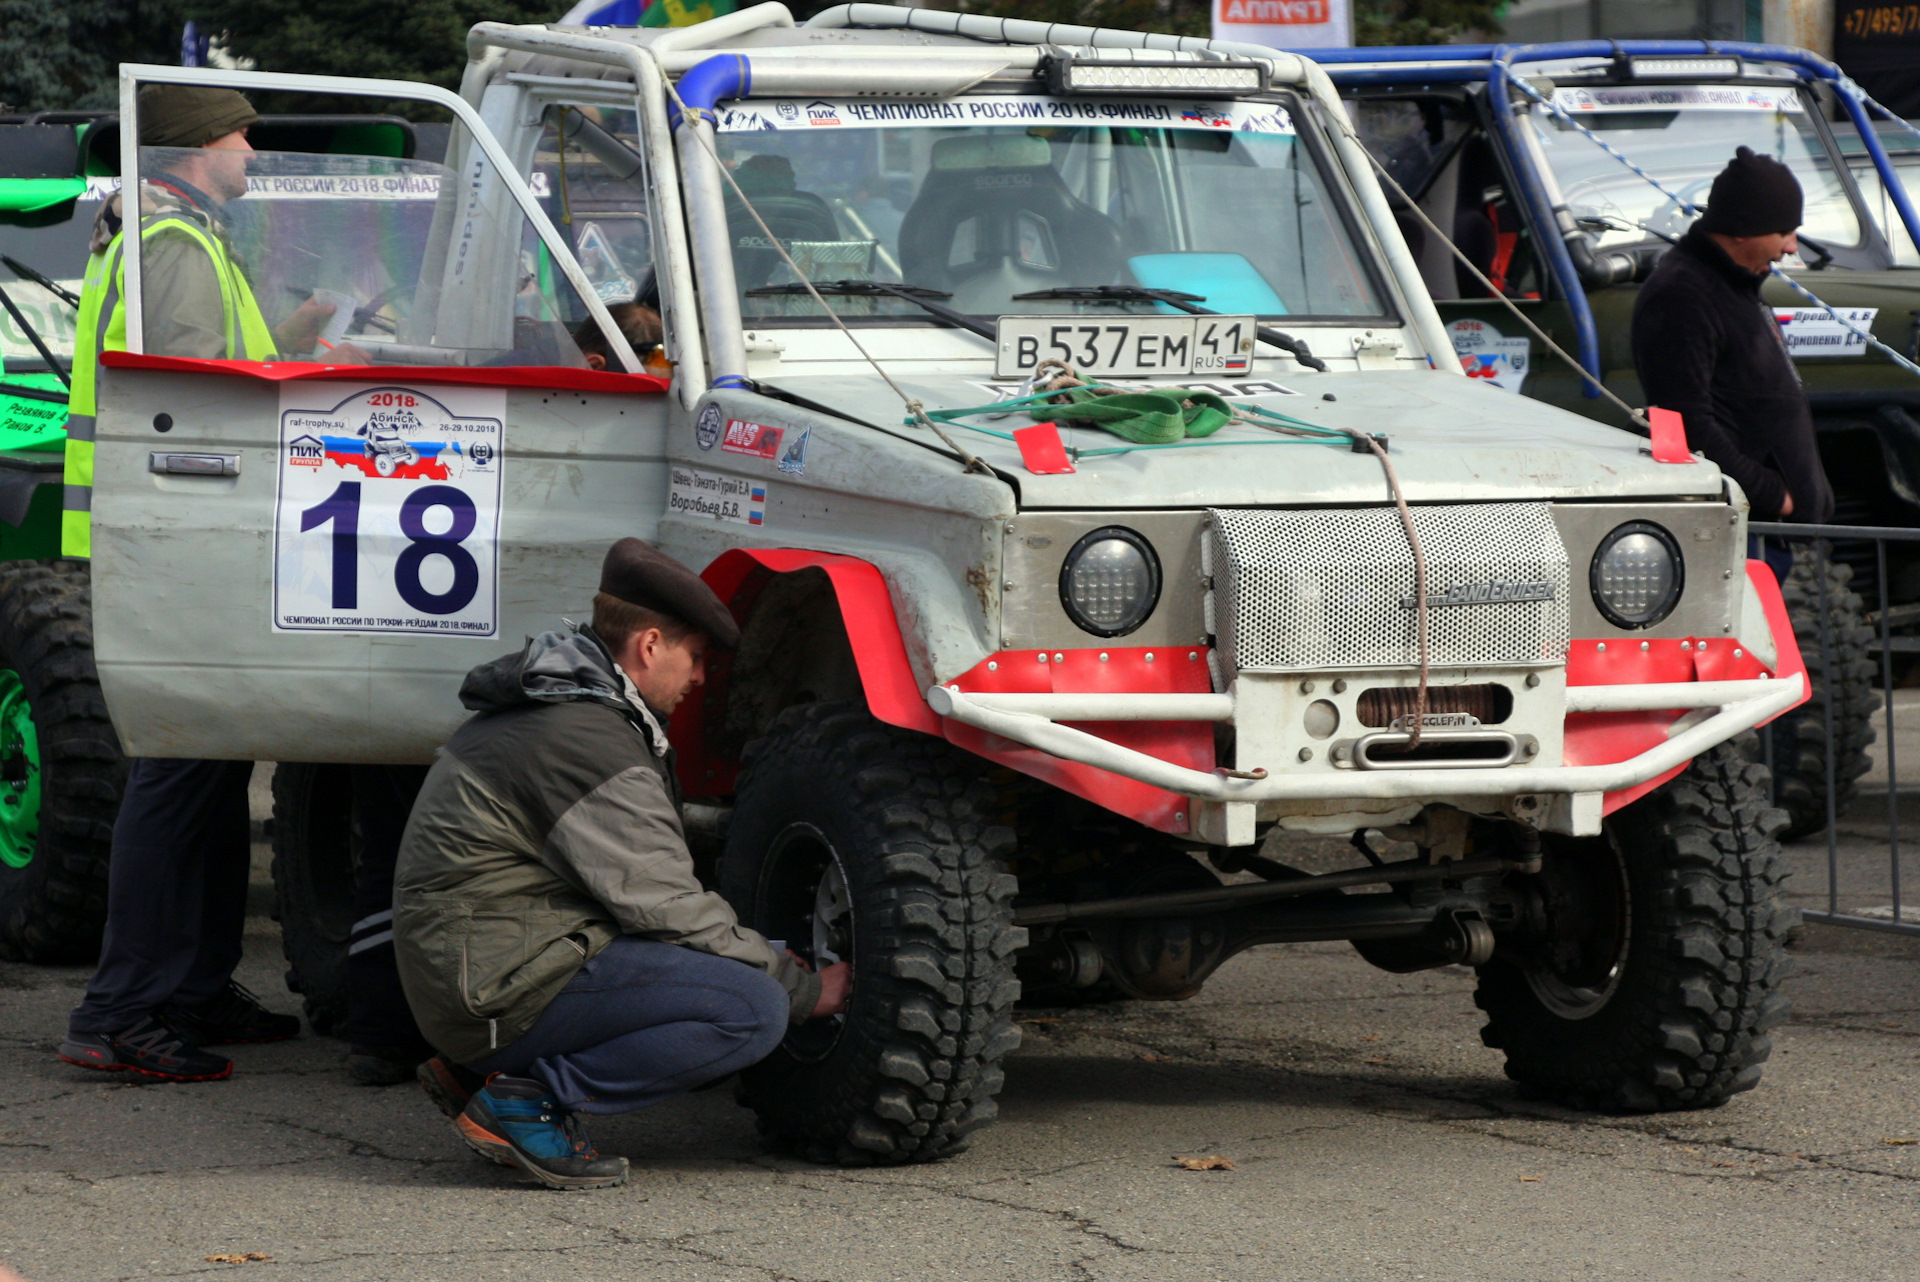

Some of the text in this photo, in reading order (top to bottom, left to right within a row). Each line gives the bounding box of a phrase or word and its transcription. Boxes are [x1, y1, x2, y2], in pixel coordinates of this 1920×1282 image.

[1845, 5, 1920, 37] +7/495/7
[807, 109, 838, 120] ПИК
[847, 102, 965, 121] ЧЕМПИОНАТ
[971, 101, 1046, 119] РОССИИ
[273, 178, 336, 193] РОССИИ
[1201, 322, 1242, 355] 41
[1787, 333, 1843, 349] Ермоленко
[1195, 356, 1225, 369] RUS
[5, 402, 58, 420] Резвяков
[369, 411, 415, 424] Абинск
[0, 418, 34, 432] Раков
[289, 418, 345, 428] raf-trophy.su
[439, 423, 496, 434] 26-29.10.2018
[724, 420, 759, 446] AVS
[289, 445, 323, 458] ПИК
[290, 457, 321, 466] ГРУППА
[670, 492, 720, 515] Воробьев
[300, 480, 479, 616] 18
[283, 615, 331, 626] ЧЕМПИОНАТ
[332, 616, 363, 627] РОССИИ
[364, 617, 375, 627] ПО
[376, 617, 438, 629] ТРОФИ-РЕЙДАМ
